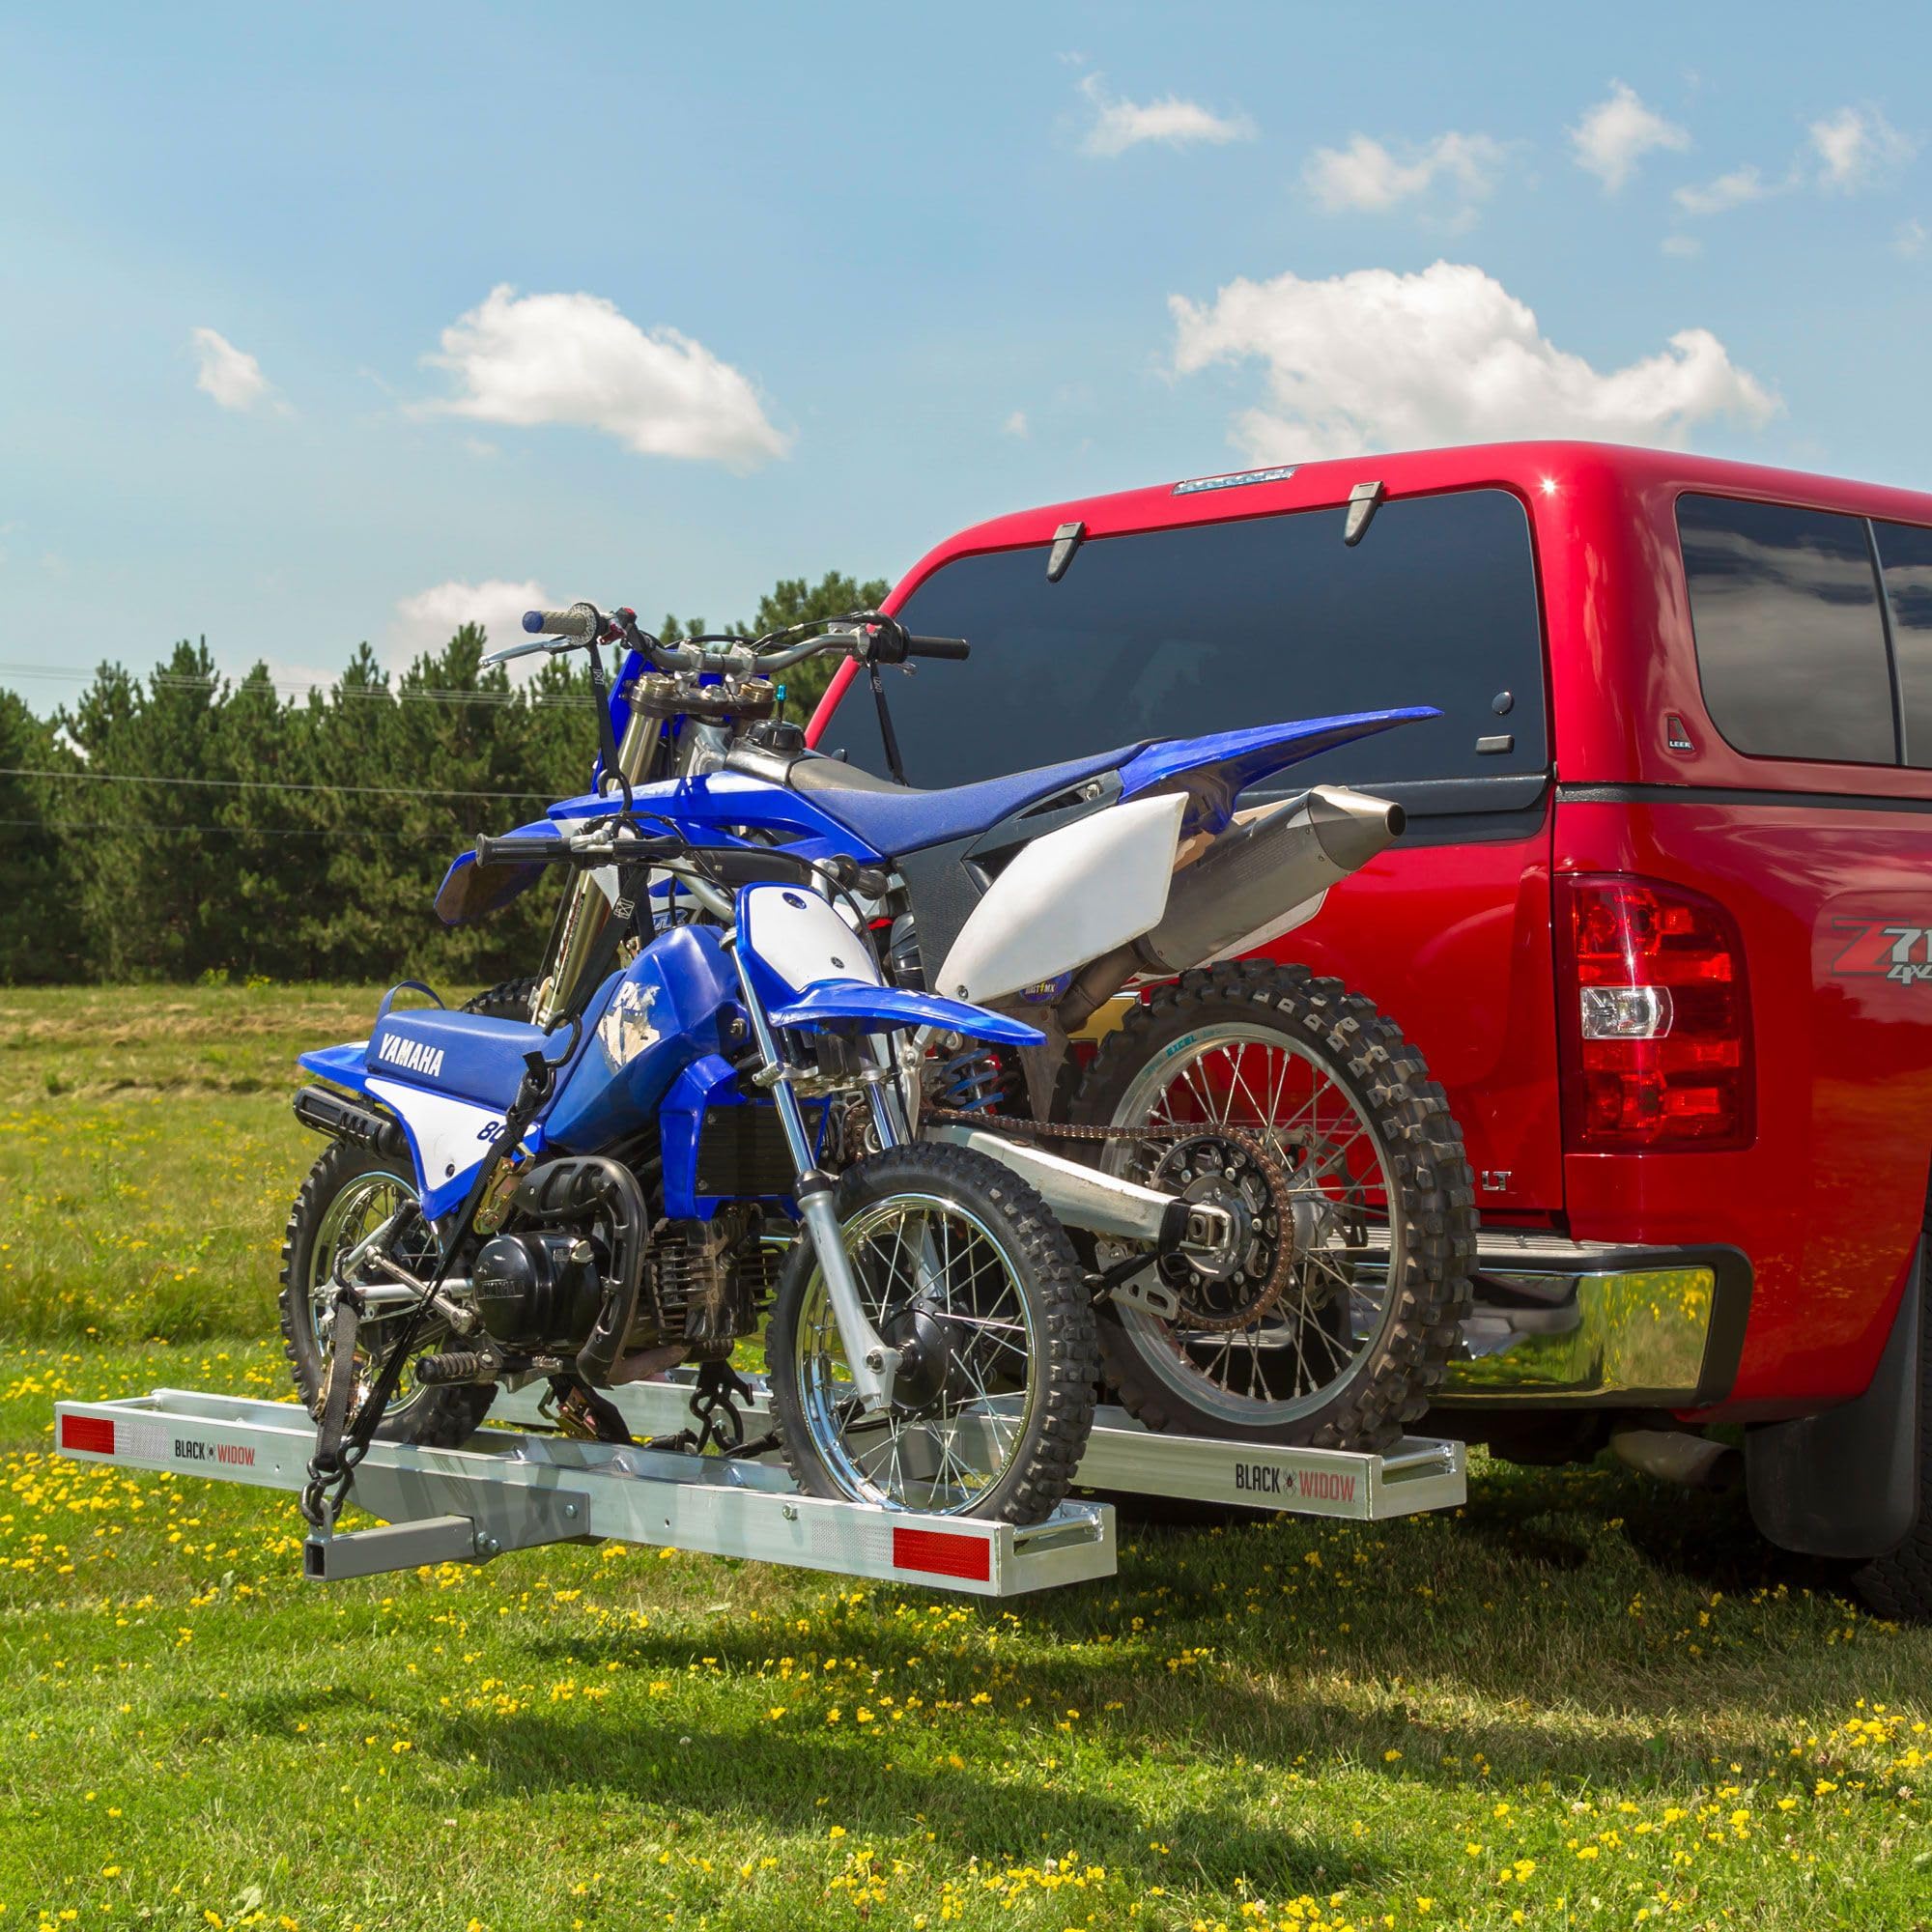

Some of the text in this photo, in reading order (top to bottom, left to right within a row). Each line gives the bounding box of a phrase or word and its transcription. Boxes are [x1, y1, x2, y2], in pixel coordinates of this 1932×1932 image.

[378, 1033, 444, 1077] YAMAHA
[1482, 1170, 1512, 1190] LT
[175, 1439, 255, 1466] BLACK WIDOW
[1236, 1463, 1355, 1502] BLACK WIDOW
